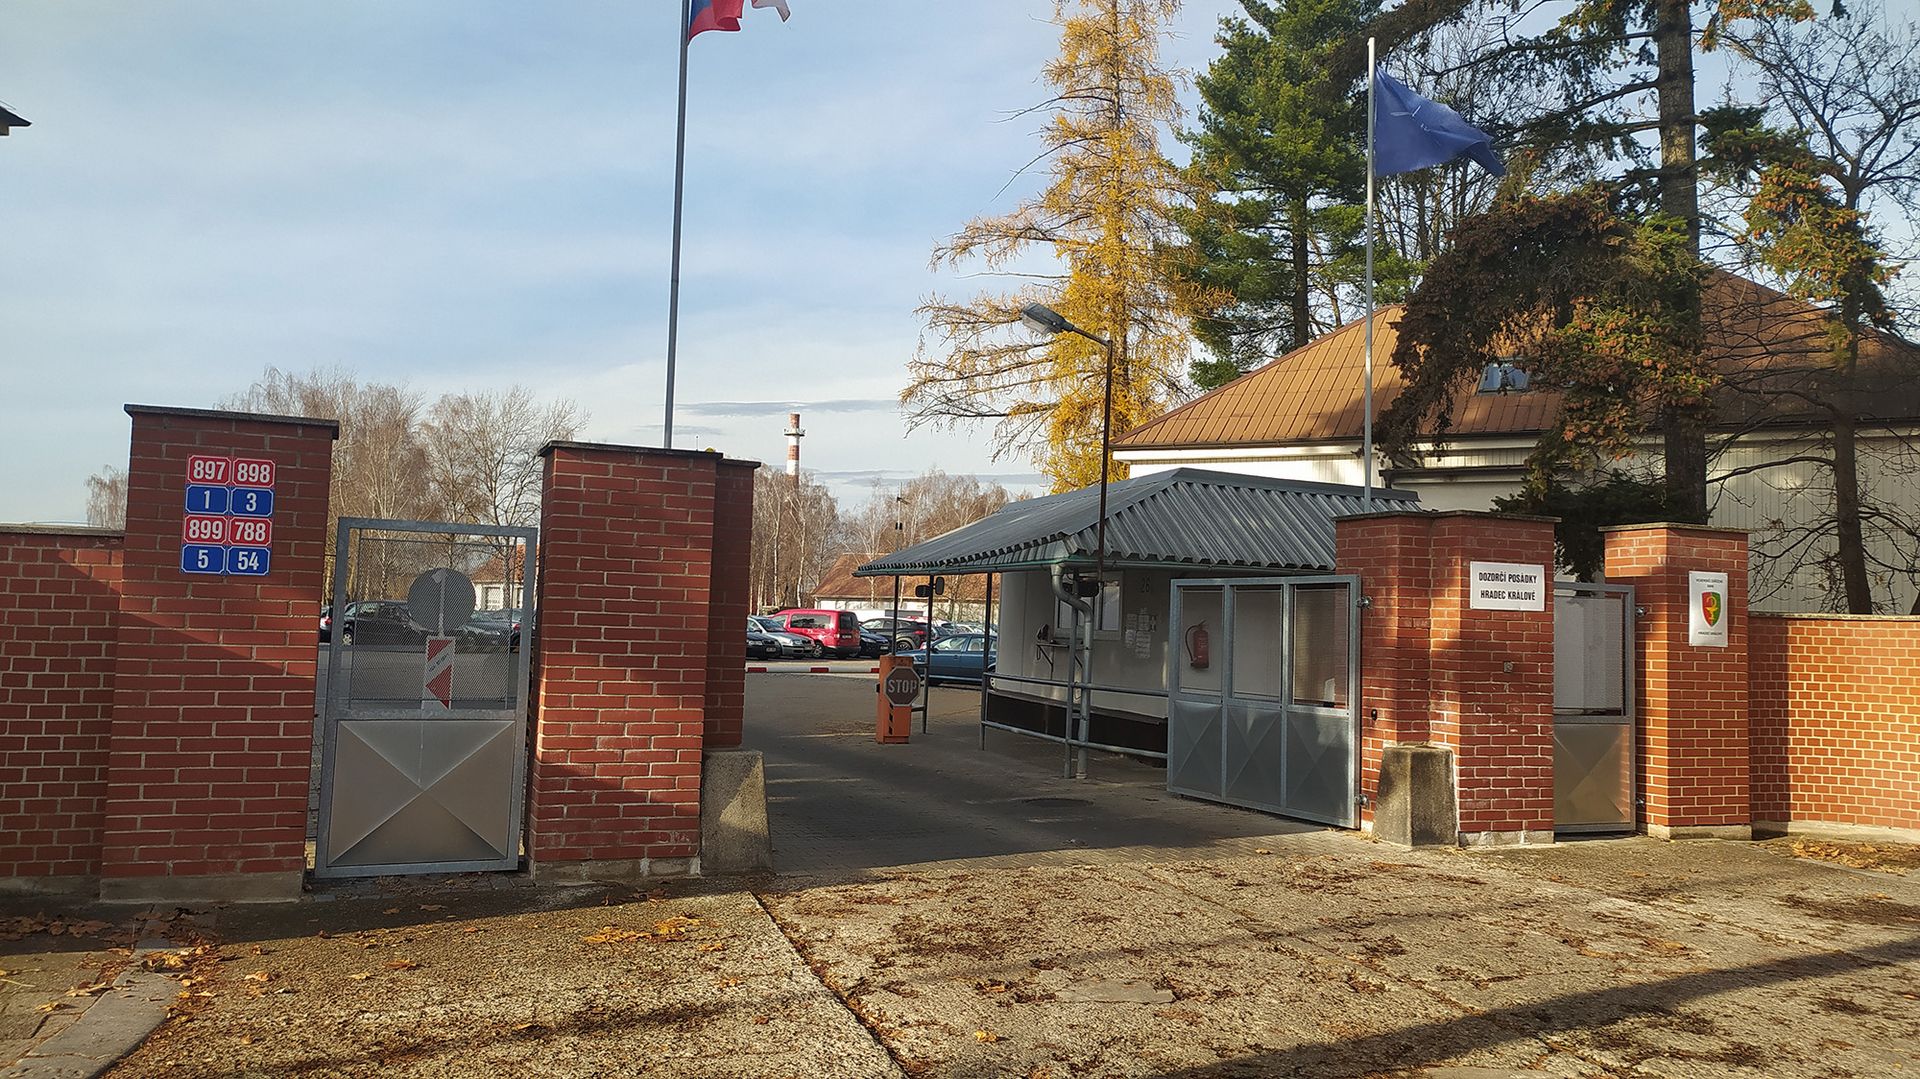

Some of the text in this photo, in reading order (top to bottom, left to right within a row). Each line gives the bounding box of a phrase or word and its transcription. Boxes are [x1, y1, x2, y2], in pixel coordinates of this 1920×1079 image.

[193, 460, 226, 480] 897
[237, 463, 271, 483] 898
[204, 490, 211, 509] 1
[246, 492, 257, 512] 3
[189, 519, 223, 539] 899
[234, 521, 266, 541] 788
[197, 549, 209, 569] 5
[238, 551, 259, 570] 54
[1479, 571, 1537, 584] DOZORČÍ POSÁDKY
[1480, 589, 1536, 601] HRADEC KRÁLOVÉ
[888, 679, 917, 693] STOP
